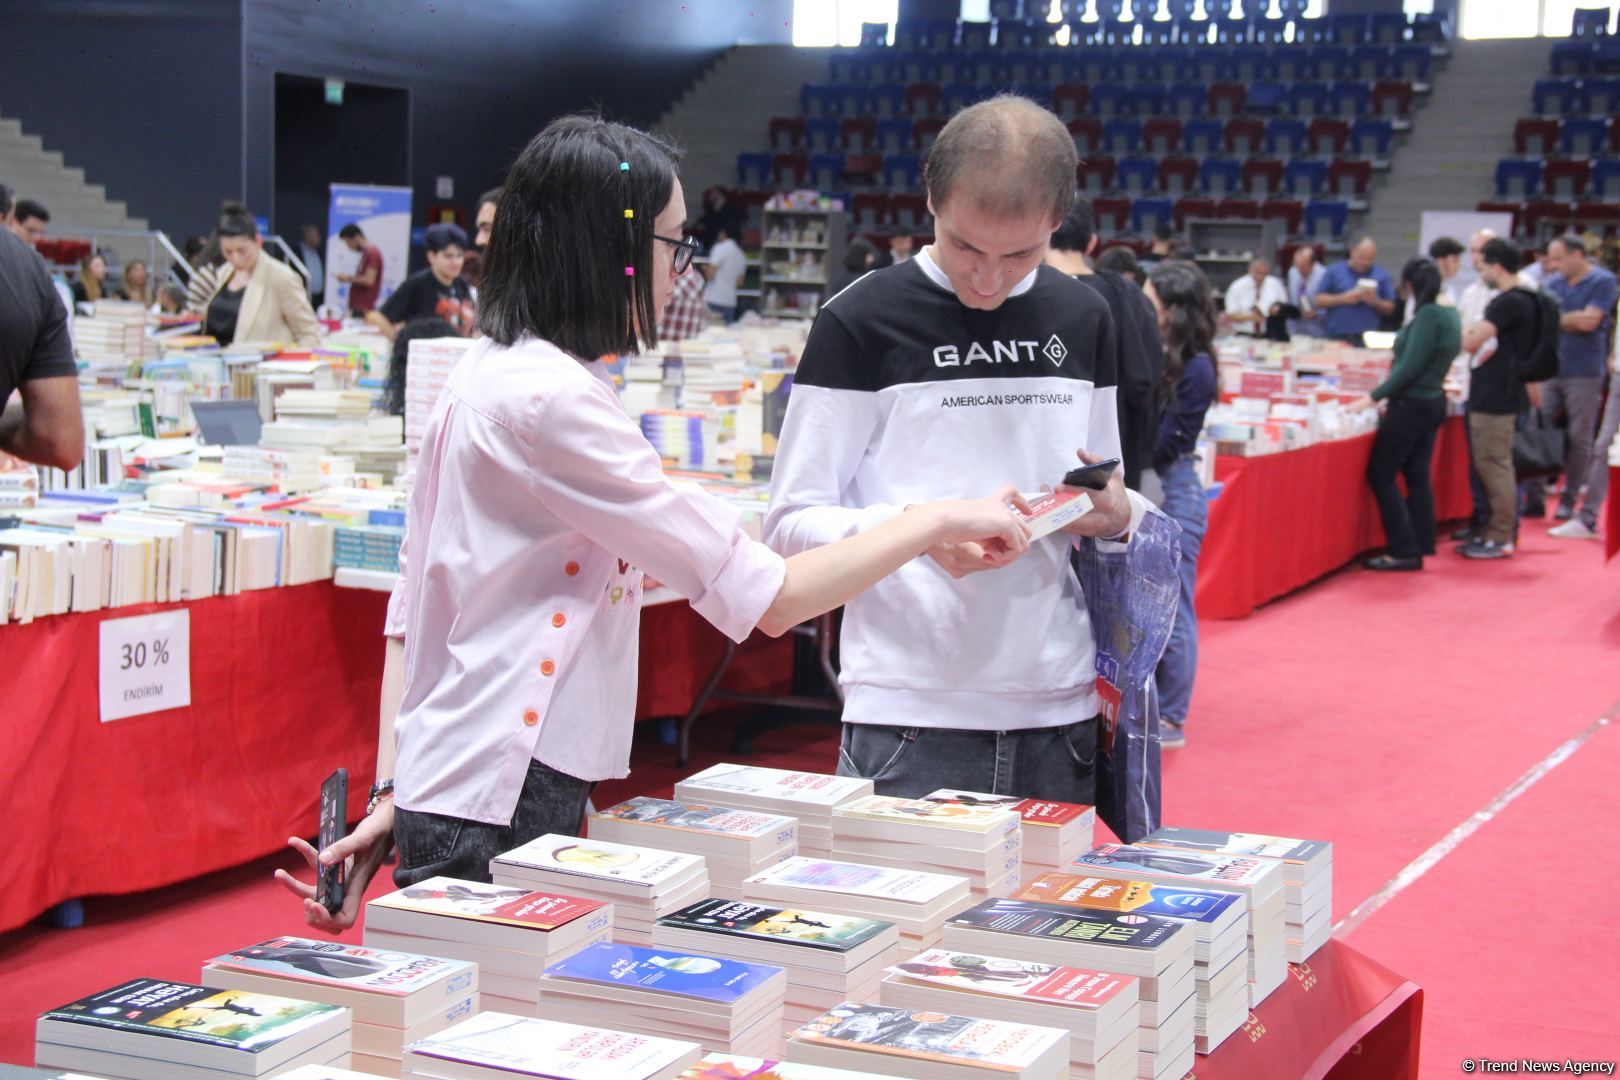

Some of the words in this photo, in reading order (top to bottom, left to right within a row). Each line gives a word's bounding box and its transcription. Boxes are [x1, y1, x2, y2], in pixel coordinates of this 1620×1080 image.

[933, 340, 1039, 367] GANT
[941, 395, 1003, 408] AMERICAN
[1005, 394, 1074, 405] SPORTSWEAR
[120, 642, 147, 671] 30
[153, 637, 170, 667] %
[123, 683, 165, 702] ENDİRİM
[126, 985, 191, 1006] HƏYAT
